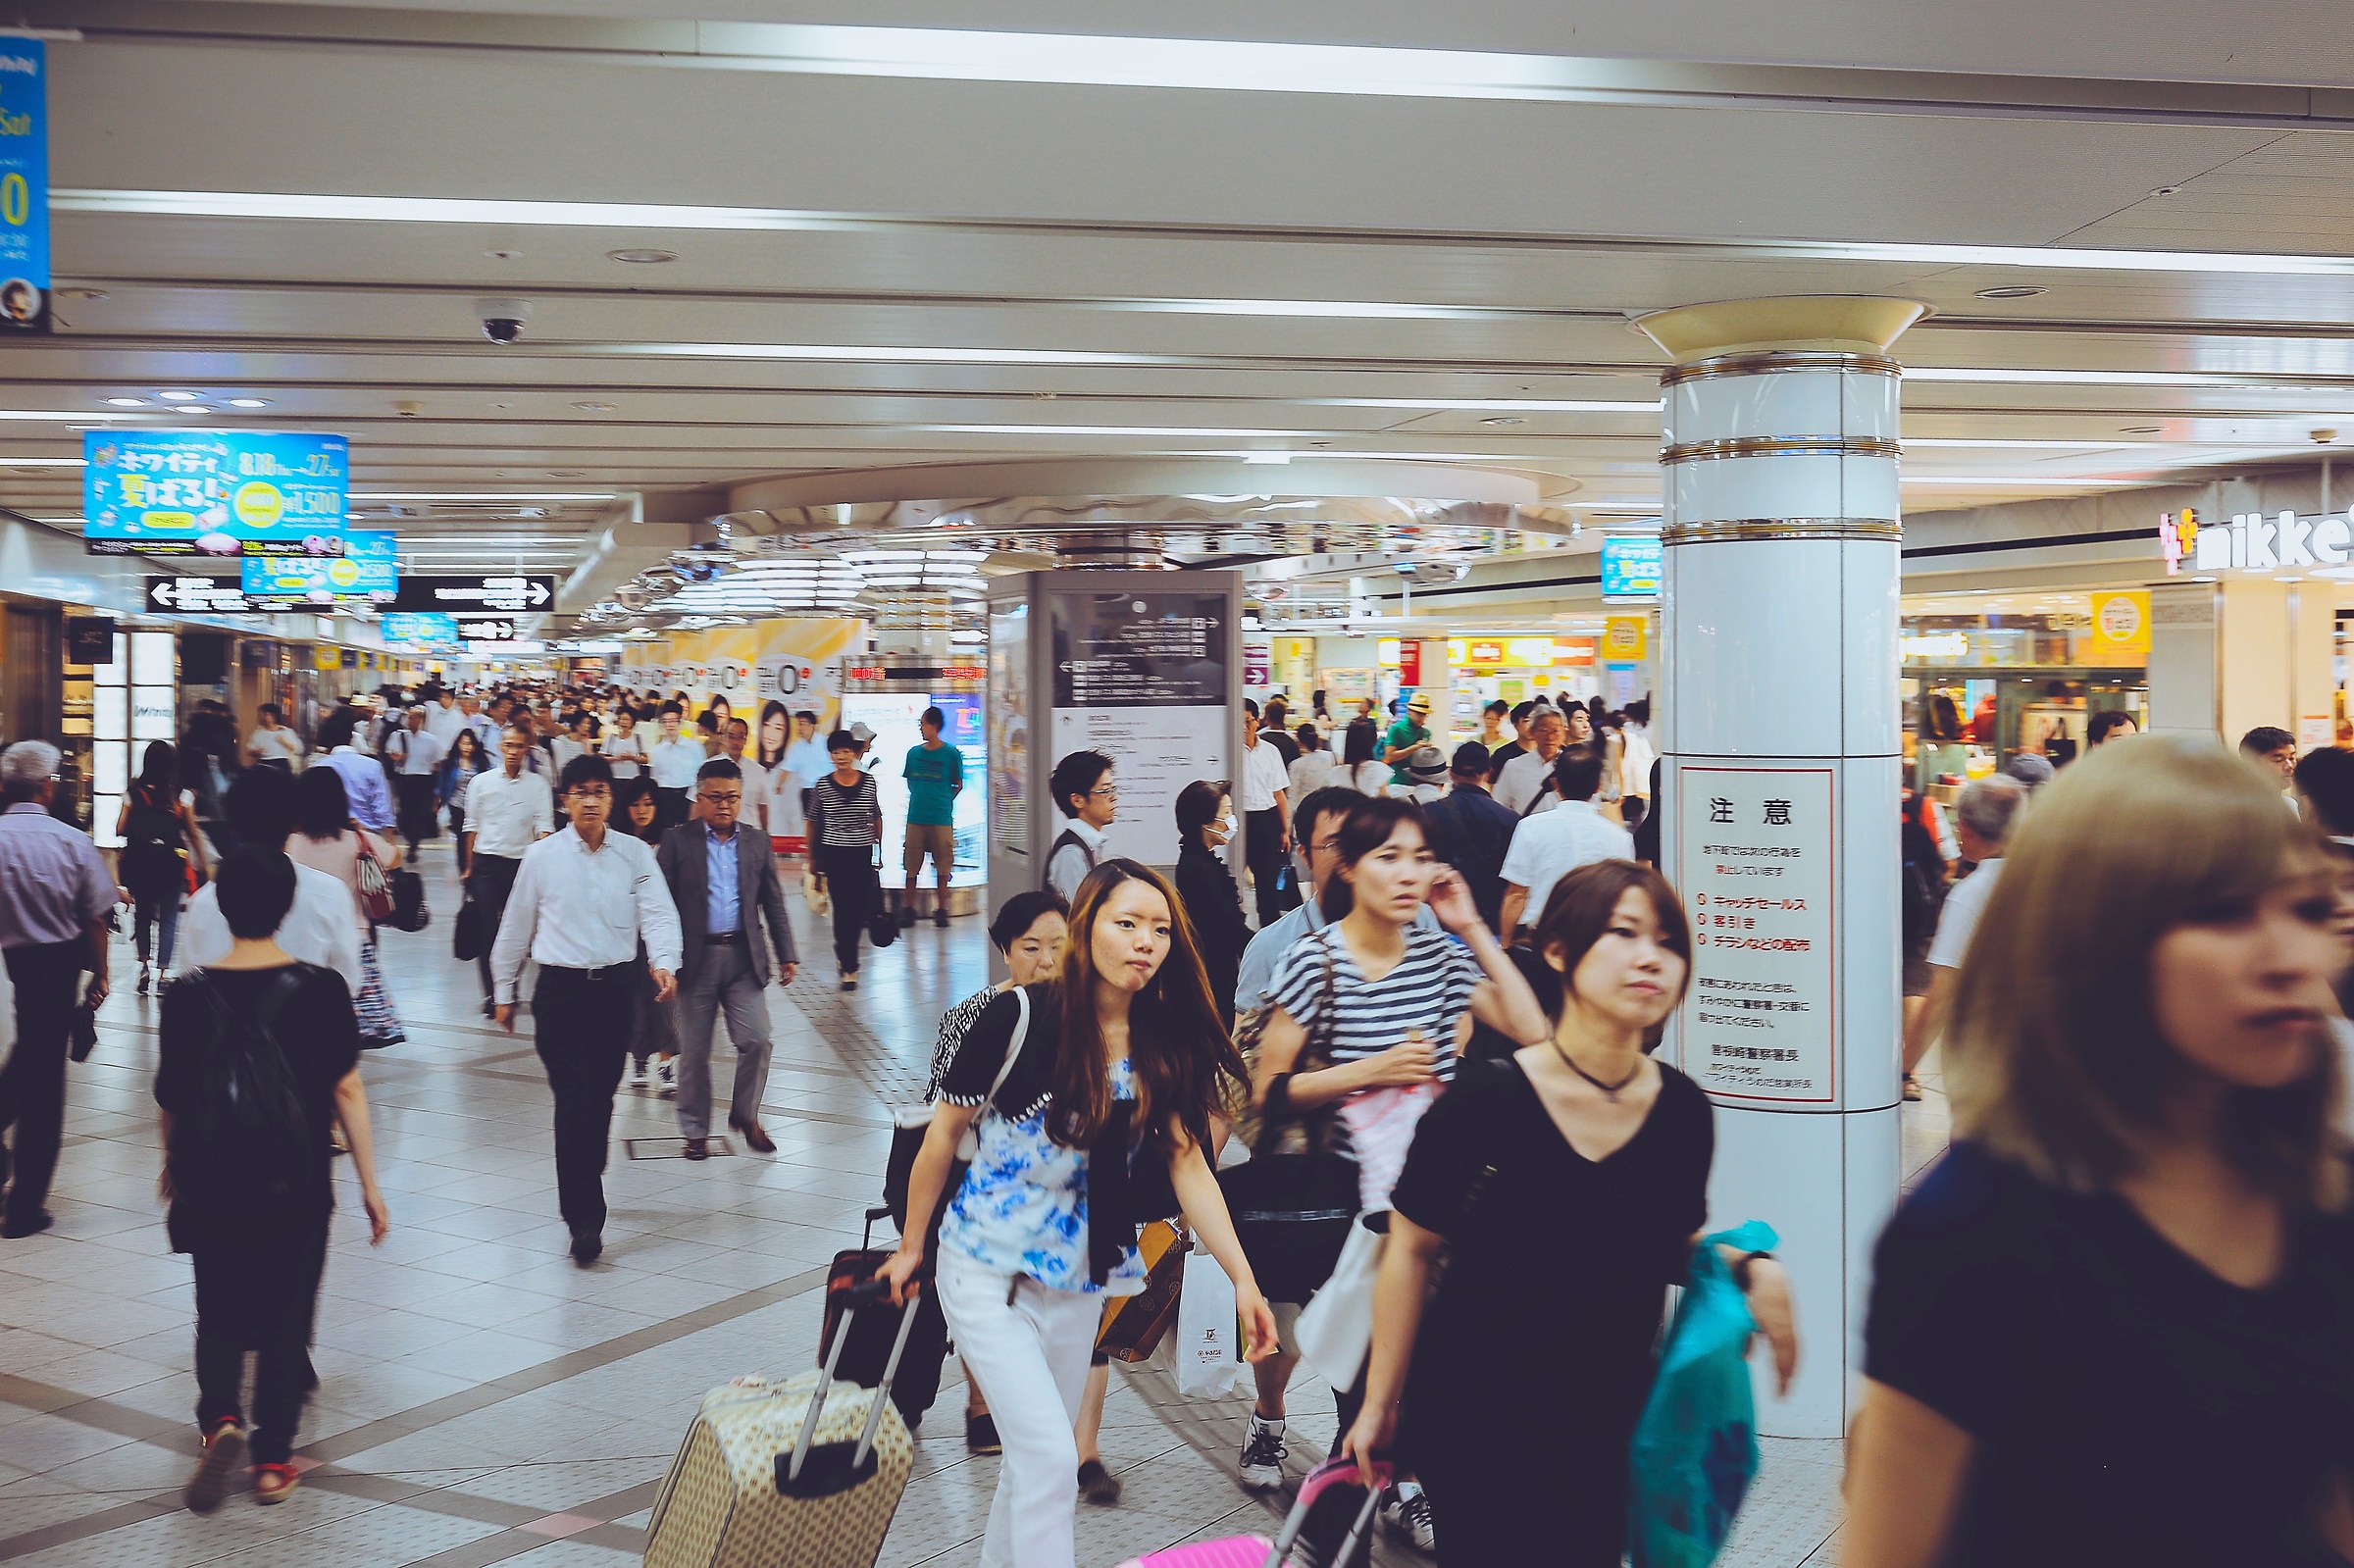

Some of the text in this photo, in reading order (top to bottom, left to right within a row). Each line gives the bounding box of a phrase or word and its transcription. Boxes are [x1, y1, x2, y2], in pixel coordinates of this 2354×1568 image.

[1714, 895, 1807, 911] キャッチセールス
[1714, 914, 1756, 930] 客引き
[1714, 935, 1811, 952] チラシなどの配布
